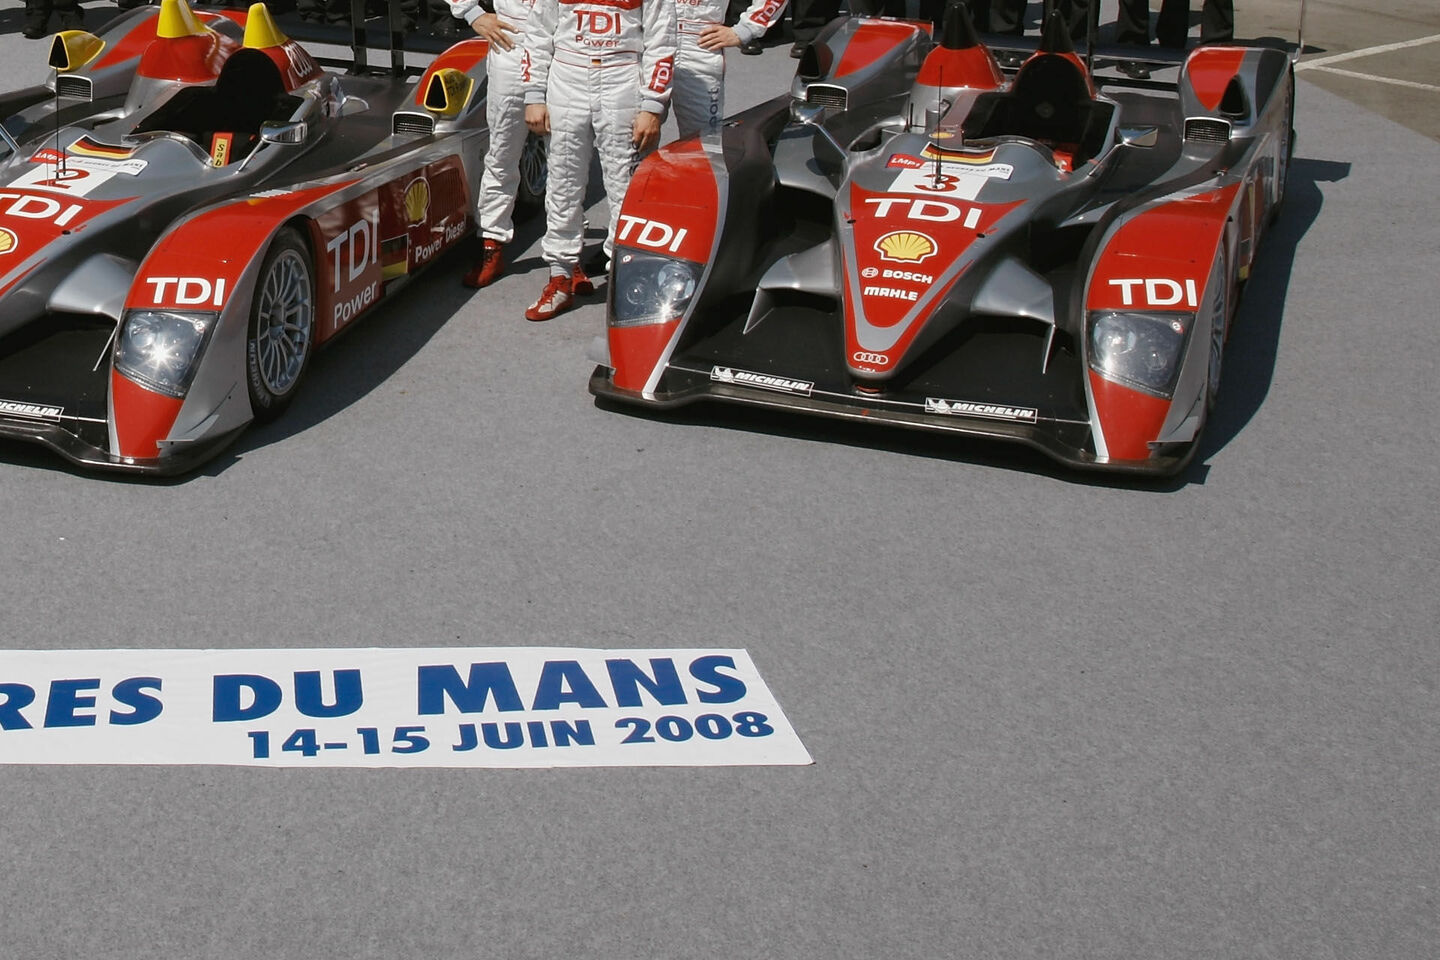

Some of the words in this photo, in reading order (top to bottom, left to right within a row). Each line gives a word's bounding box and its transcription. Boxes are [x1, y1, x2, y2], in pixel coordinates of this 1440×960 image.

[573, 10, 621, 35] TDI
[755, 0, 781, 24] TDI
[576, 35, 619, 47] Power
[654, 62, 671, 89] TDI
[31, 168, 90, 189] 2
[914, 174, 961, 192] 3
[865, 198, 982, 229] TDI
[618, 215, 688, 253] TDI
[327, 209, 380, 293] TDI
[882, 269, 933, 284] BOSCH
[146, 278, 226, 306] TDI
[333, 281, 376, 329] Power
[864, 286, 918, 301] MAHLE
[1109, 278, 1198, 307] TDI
[735, 372, 809, 390] MICHELIN
[951, 403, 1033, 418] MICHELIN
[212, 669, 363, 722] DU
[417, 654, 748, 715] MANS
[248, 726, 430, 759] 14-15
[452, 720, 595, 751] JUIN
[614, 711, 774, 744] 2008
